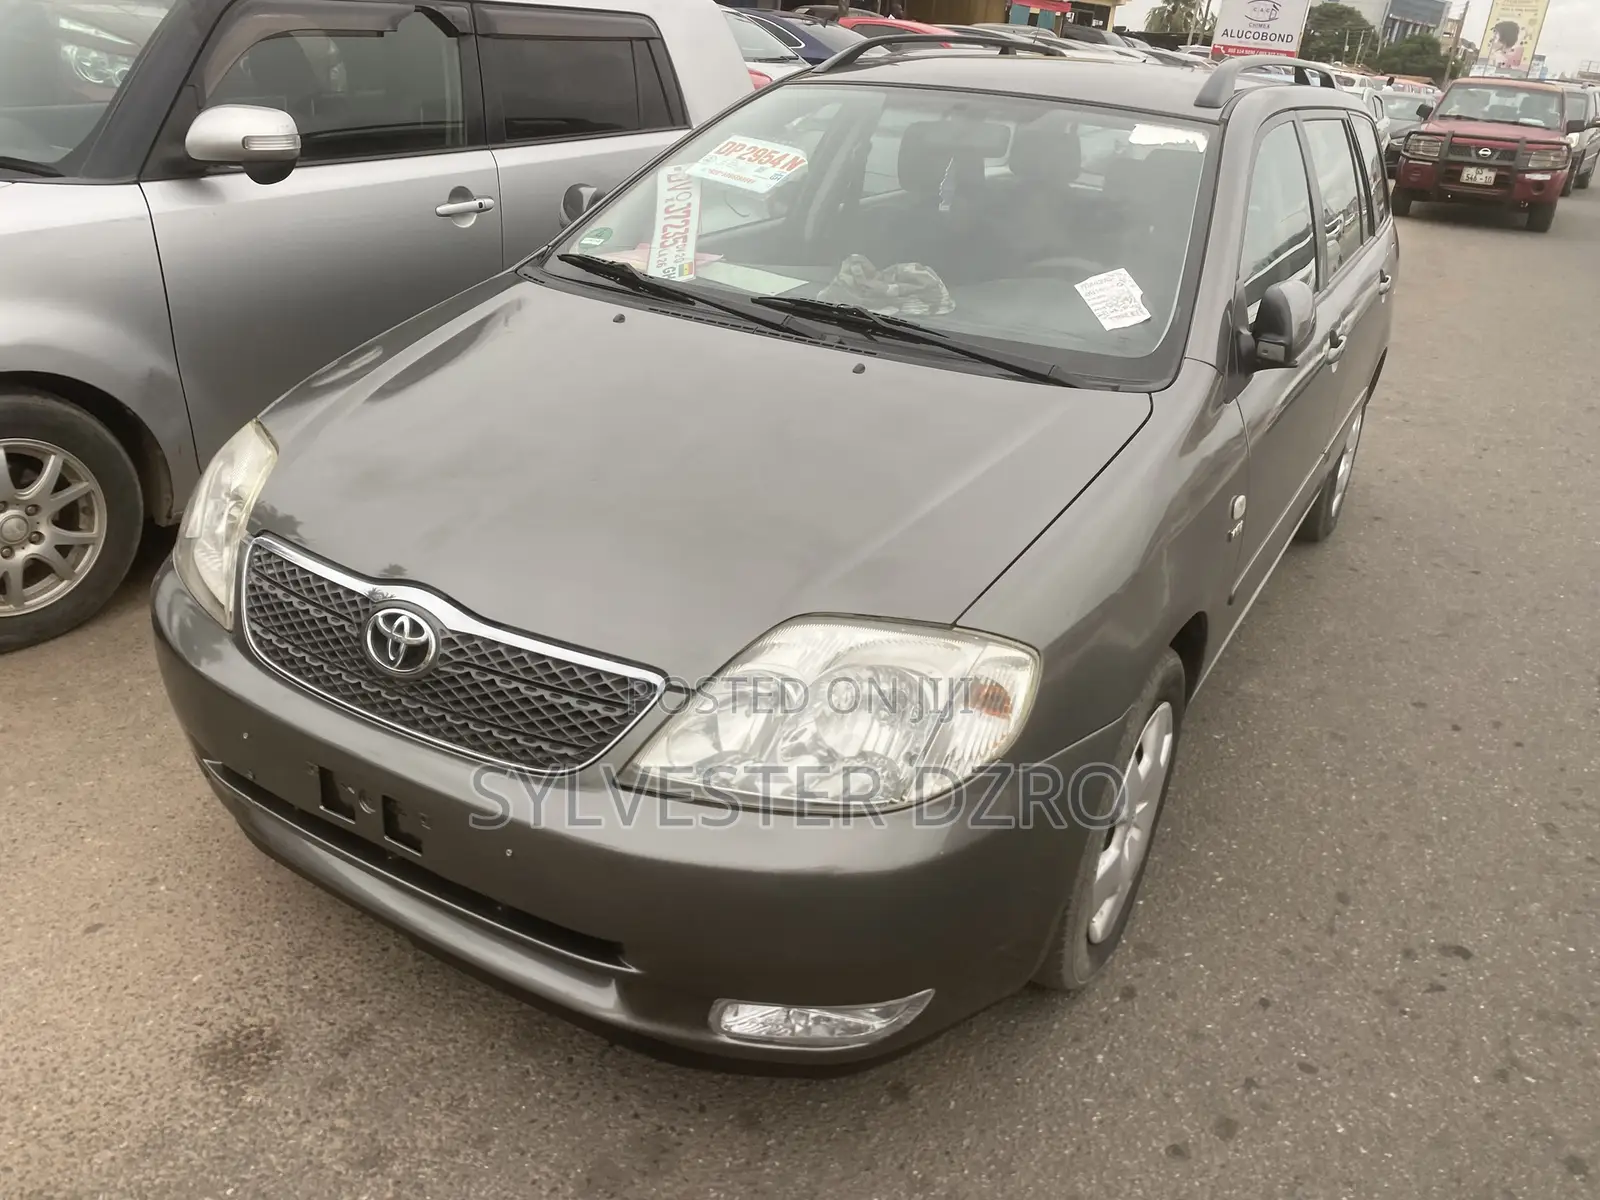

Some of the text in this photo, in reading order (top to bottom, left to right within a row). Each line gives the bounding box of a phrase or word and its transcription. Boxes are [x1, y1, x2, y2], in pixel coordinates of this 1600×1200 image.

[1221, 28, 1294, 43] ALUCOBOND
[714, 141, 747, 156] DP
[736, 146, 790, 169] 2954
[780, 155, 806, 172] N
